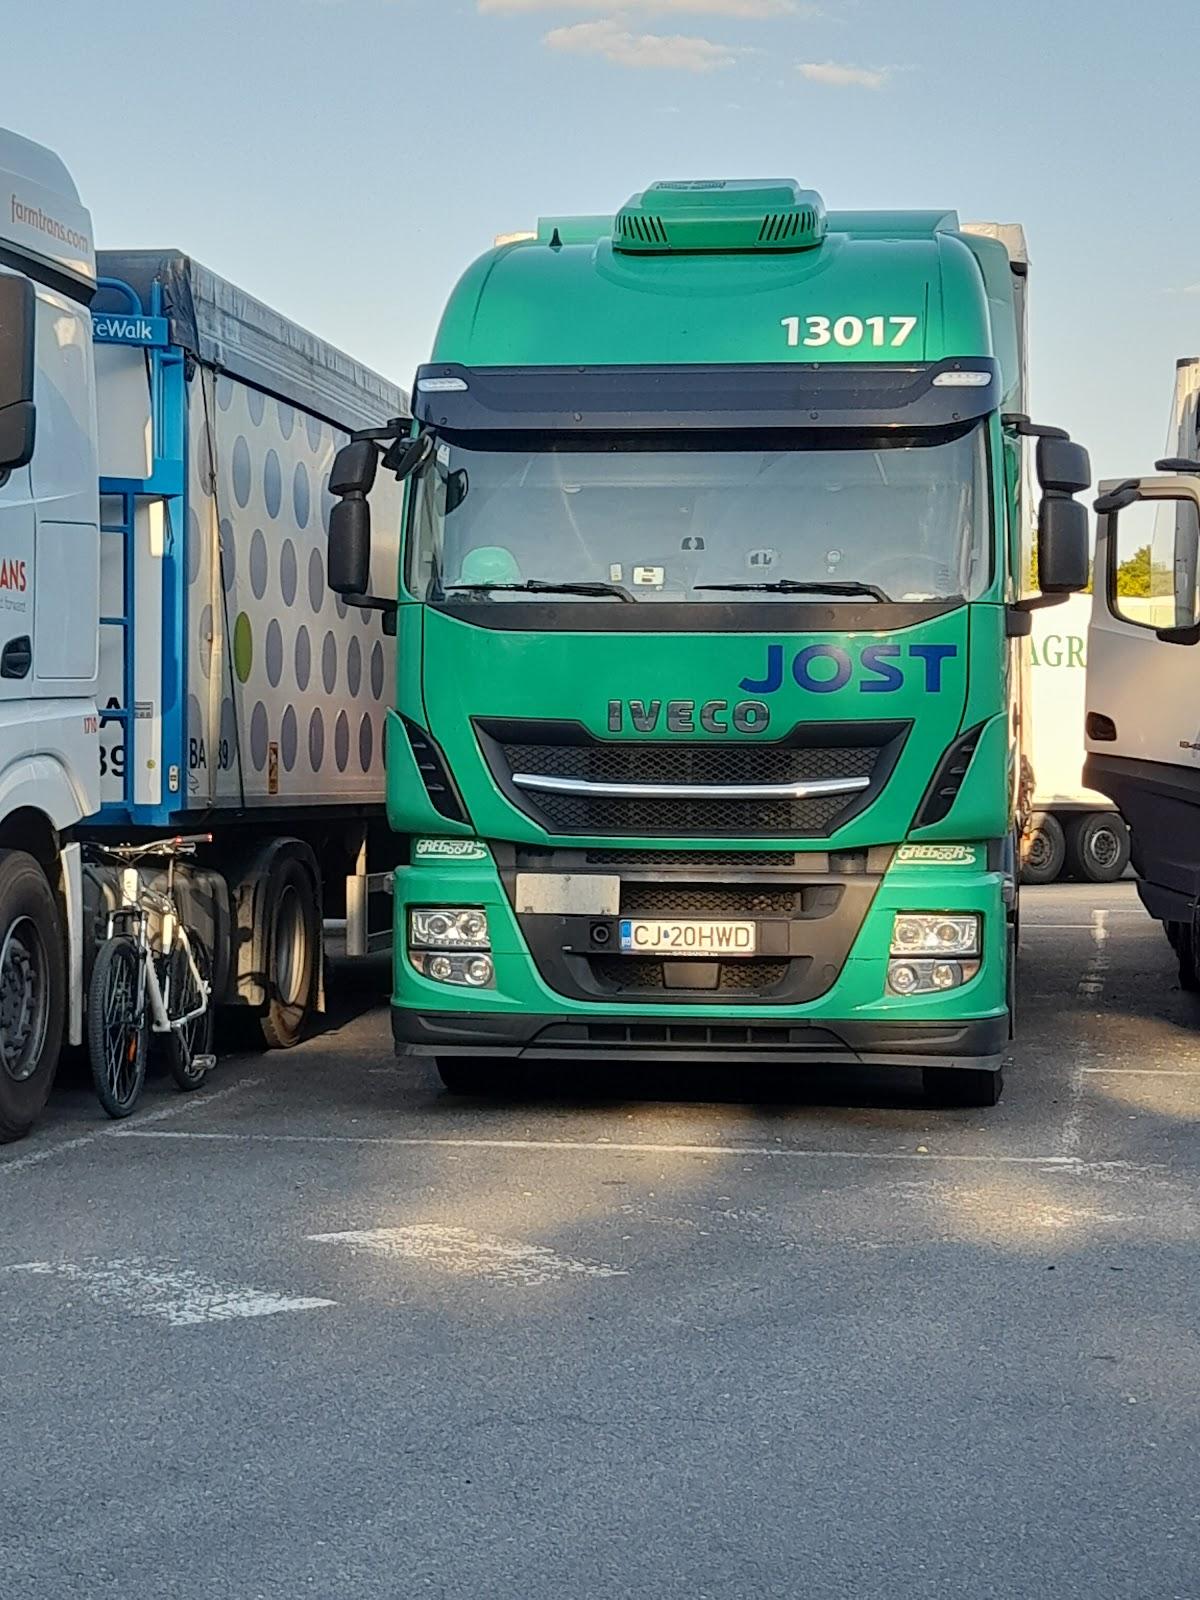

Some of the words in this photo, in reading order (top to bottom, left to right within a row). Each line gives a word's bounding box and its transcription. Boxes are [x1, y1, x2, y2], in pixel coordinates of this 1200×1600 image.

[11, 193, 88, 254] farmtrans.com
[781, 315, 917, 346] 13017
[738, 644, 957, 693] JOST
[607, 700, 771, 733] IVECO
